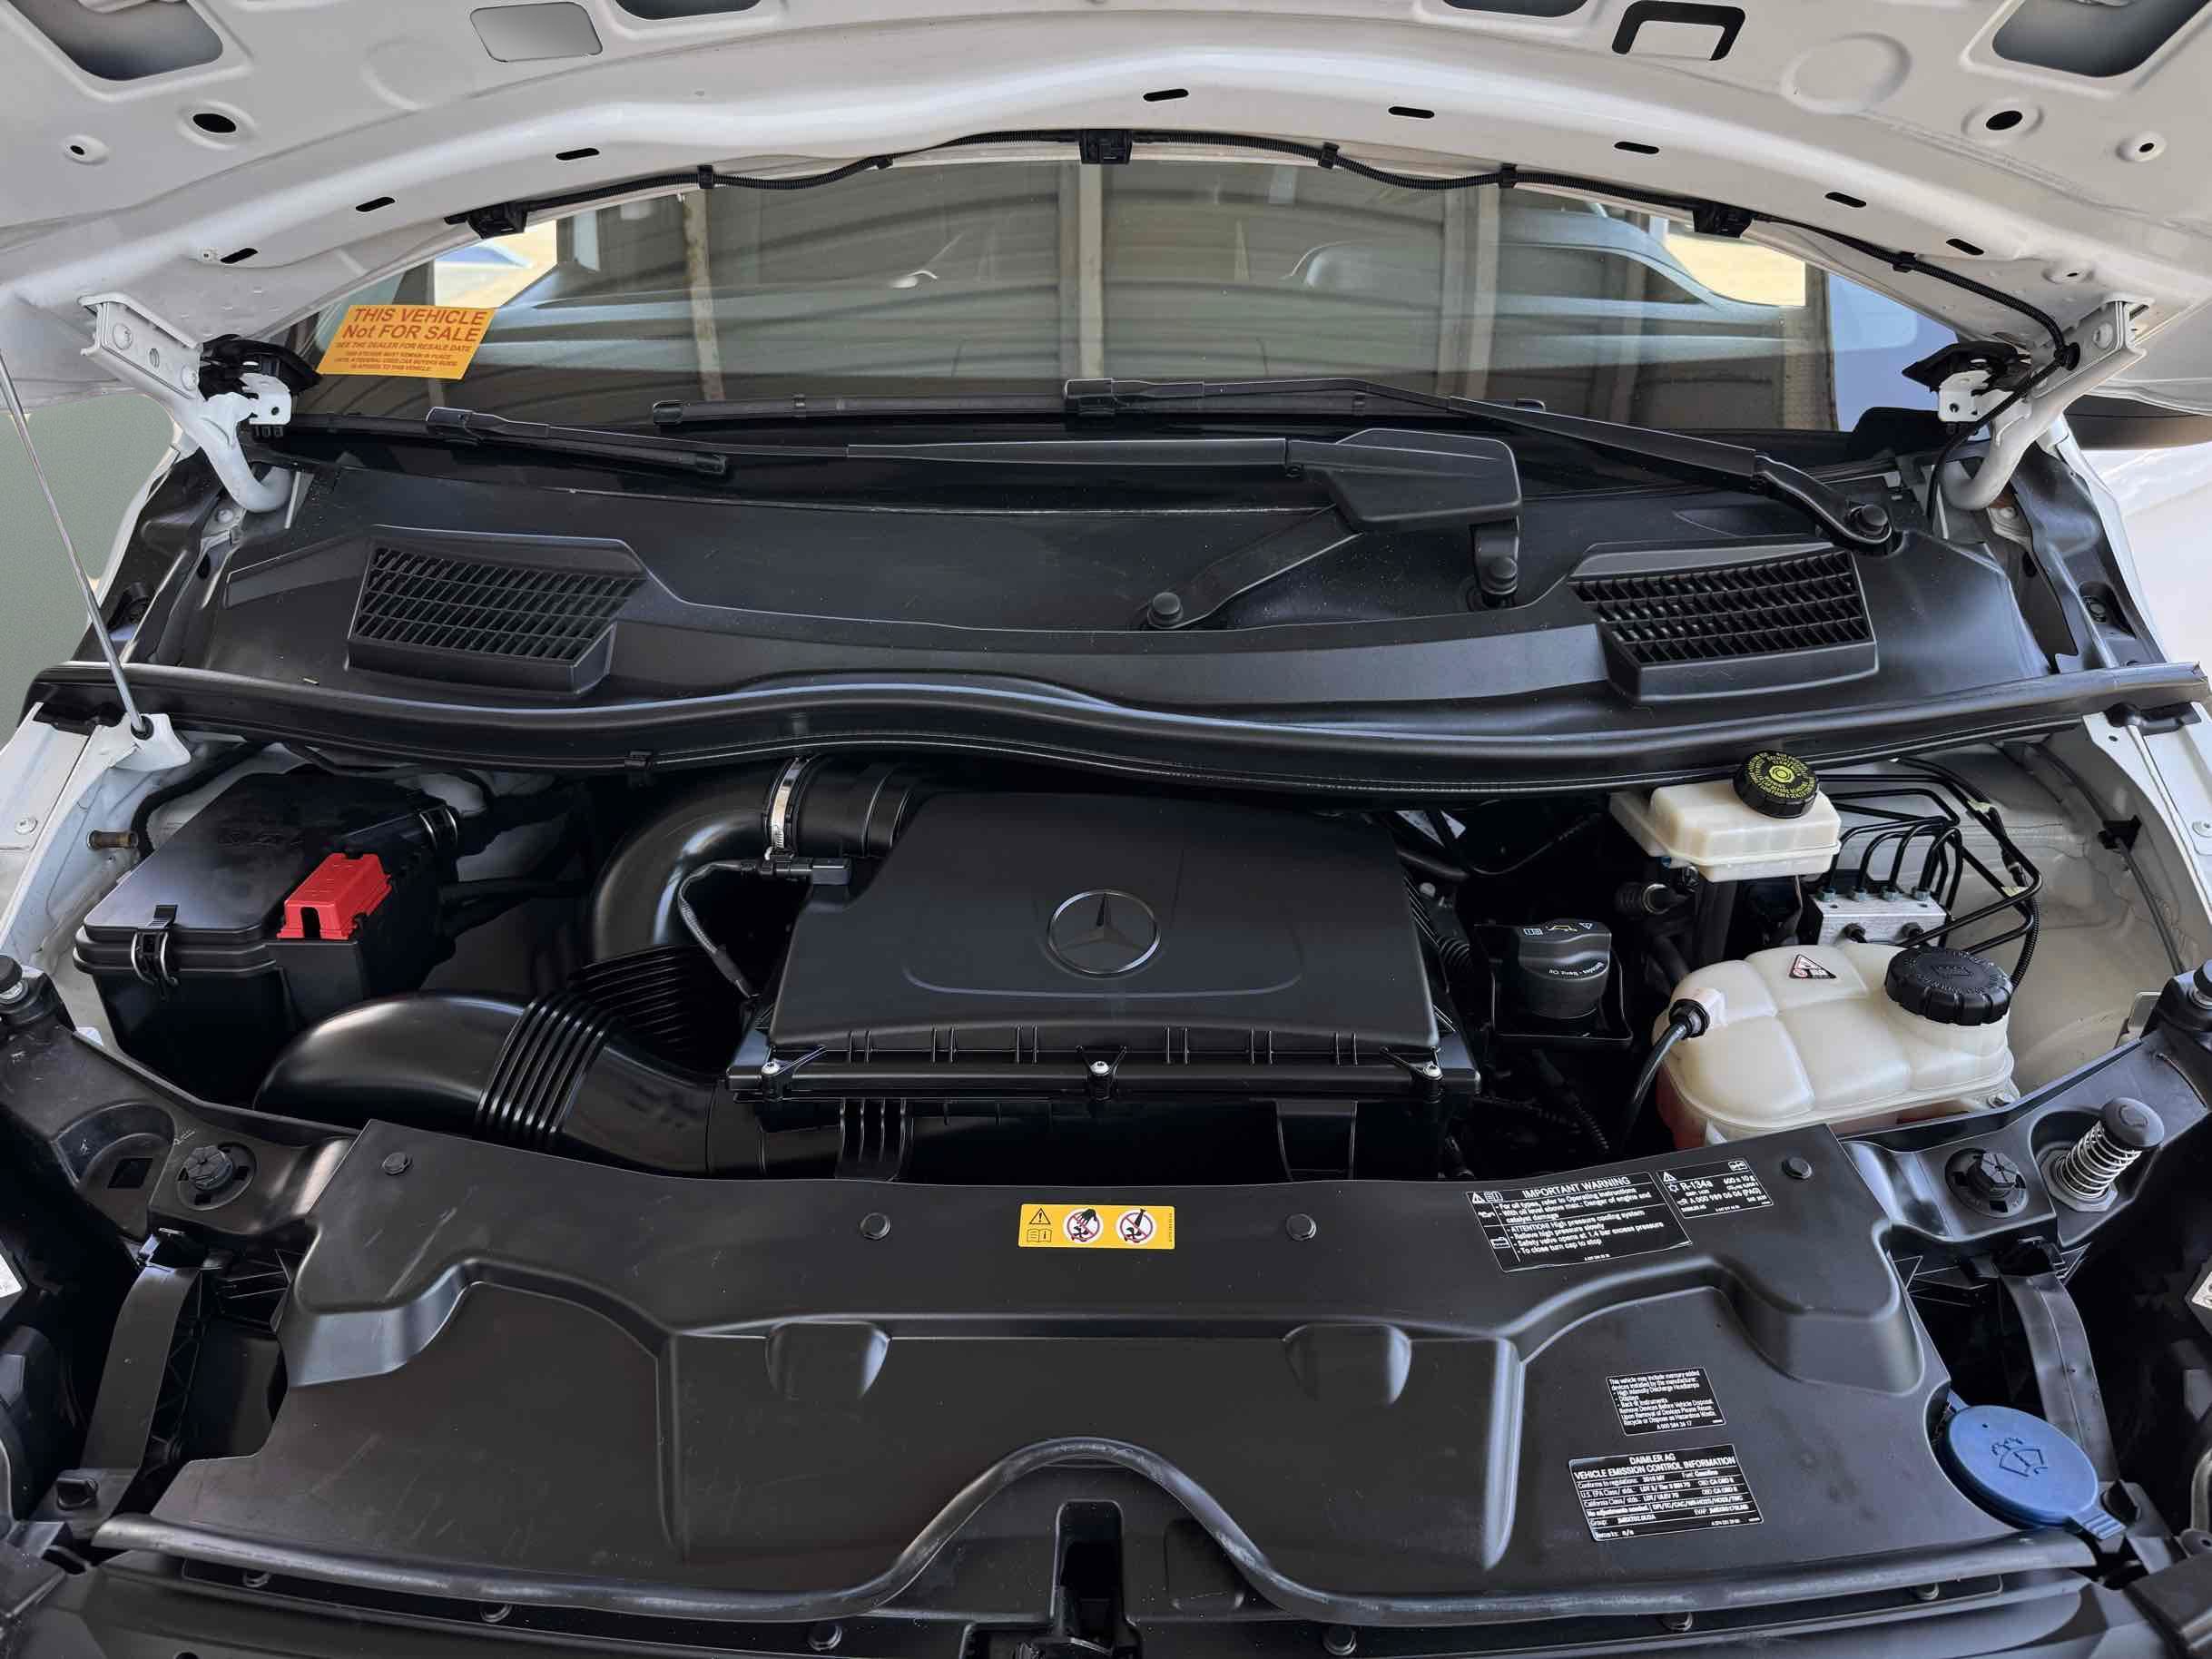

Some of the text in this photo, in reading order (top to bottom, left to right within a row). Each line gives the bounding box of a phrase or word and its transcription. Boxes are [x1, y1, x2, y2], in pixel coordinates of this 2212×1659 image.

[354, 309, 487, 325] THIS VEHICLE
[342, 324, 481, 342] Not FOR SALE
[1522, 1176, 1631, 1199] IMPORTANT WARNING
[1680, 1180, 1714, 1192] R-134a
[1501, 1209, 1519, 1217] With
[1583, 1199, 1607, 1207] Danger
[1616, 1193, 1637, 1203] engine
[1638, 1191, 1652, 1199] and
[1541, 1198, 1558, 1206] refer
[1566, 1192, 1599, 1203] Operating
[1550, 1220, 1567, 1229] High
[1568, 1217, 1596, 1227] pressure
[1597, 1213, 1621, 1222] cooling
[1621, 1210, 1645, 1219] system
[1635, 1222, 1664, 1232] pressure
[1539, 1229, 1554, 1239] high
[1554, 1225, 1583, 1236] pressure
[1565, 1241, 1578, 1249] cap
[1629, 1452, 1676, 1465] DAIMLER AG
[1574, 1456, 1735, 1480] VEHICLE EMISSION CONTROL INFORMATION
